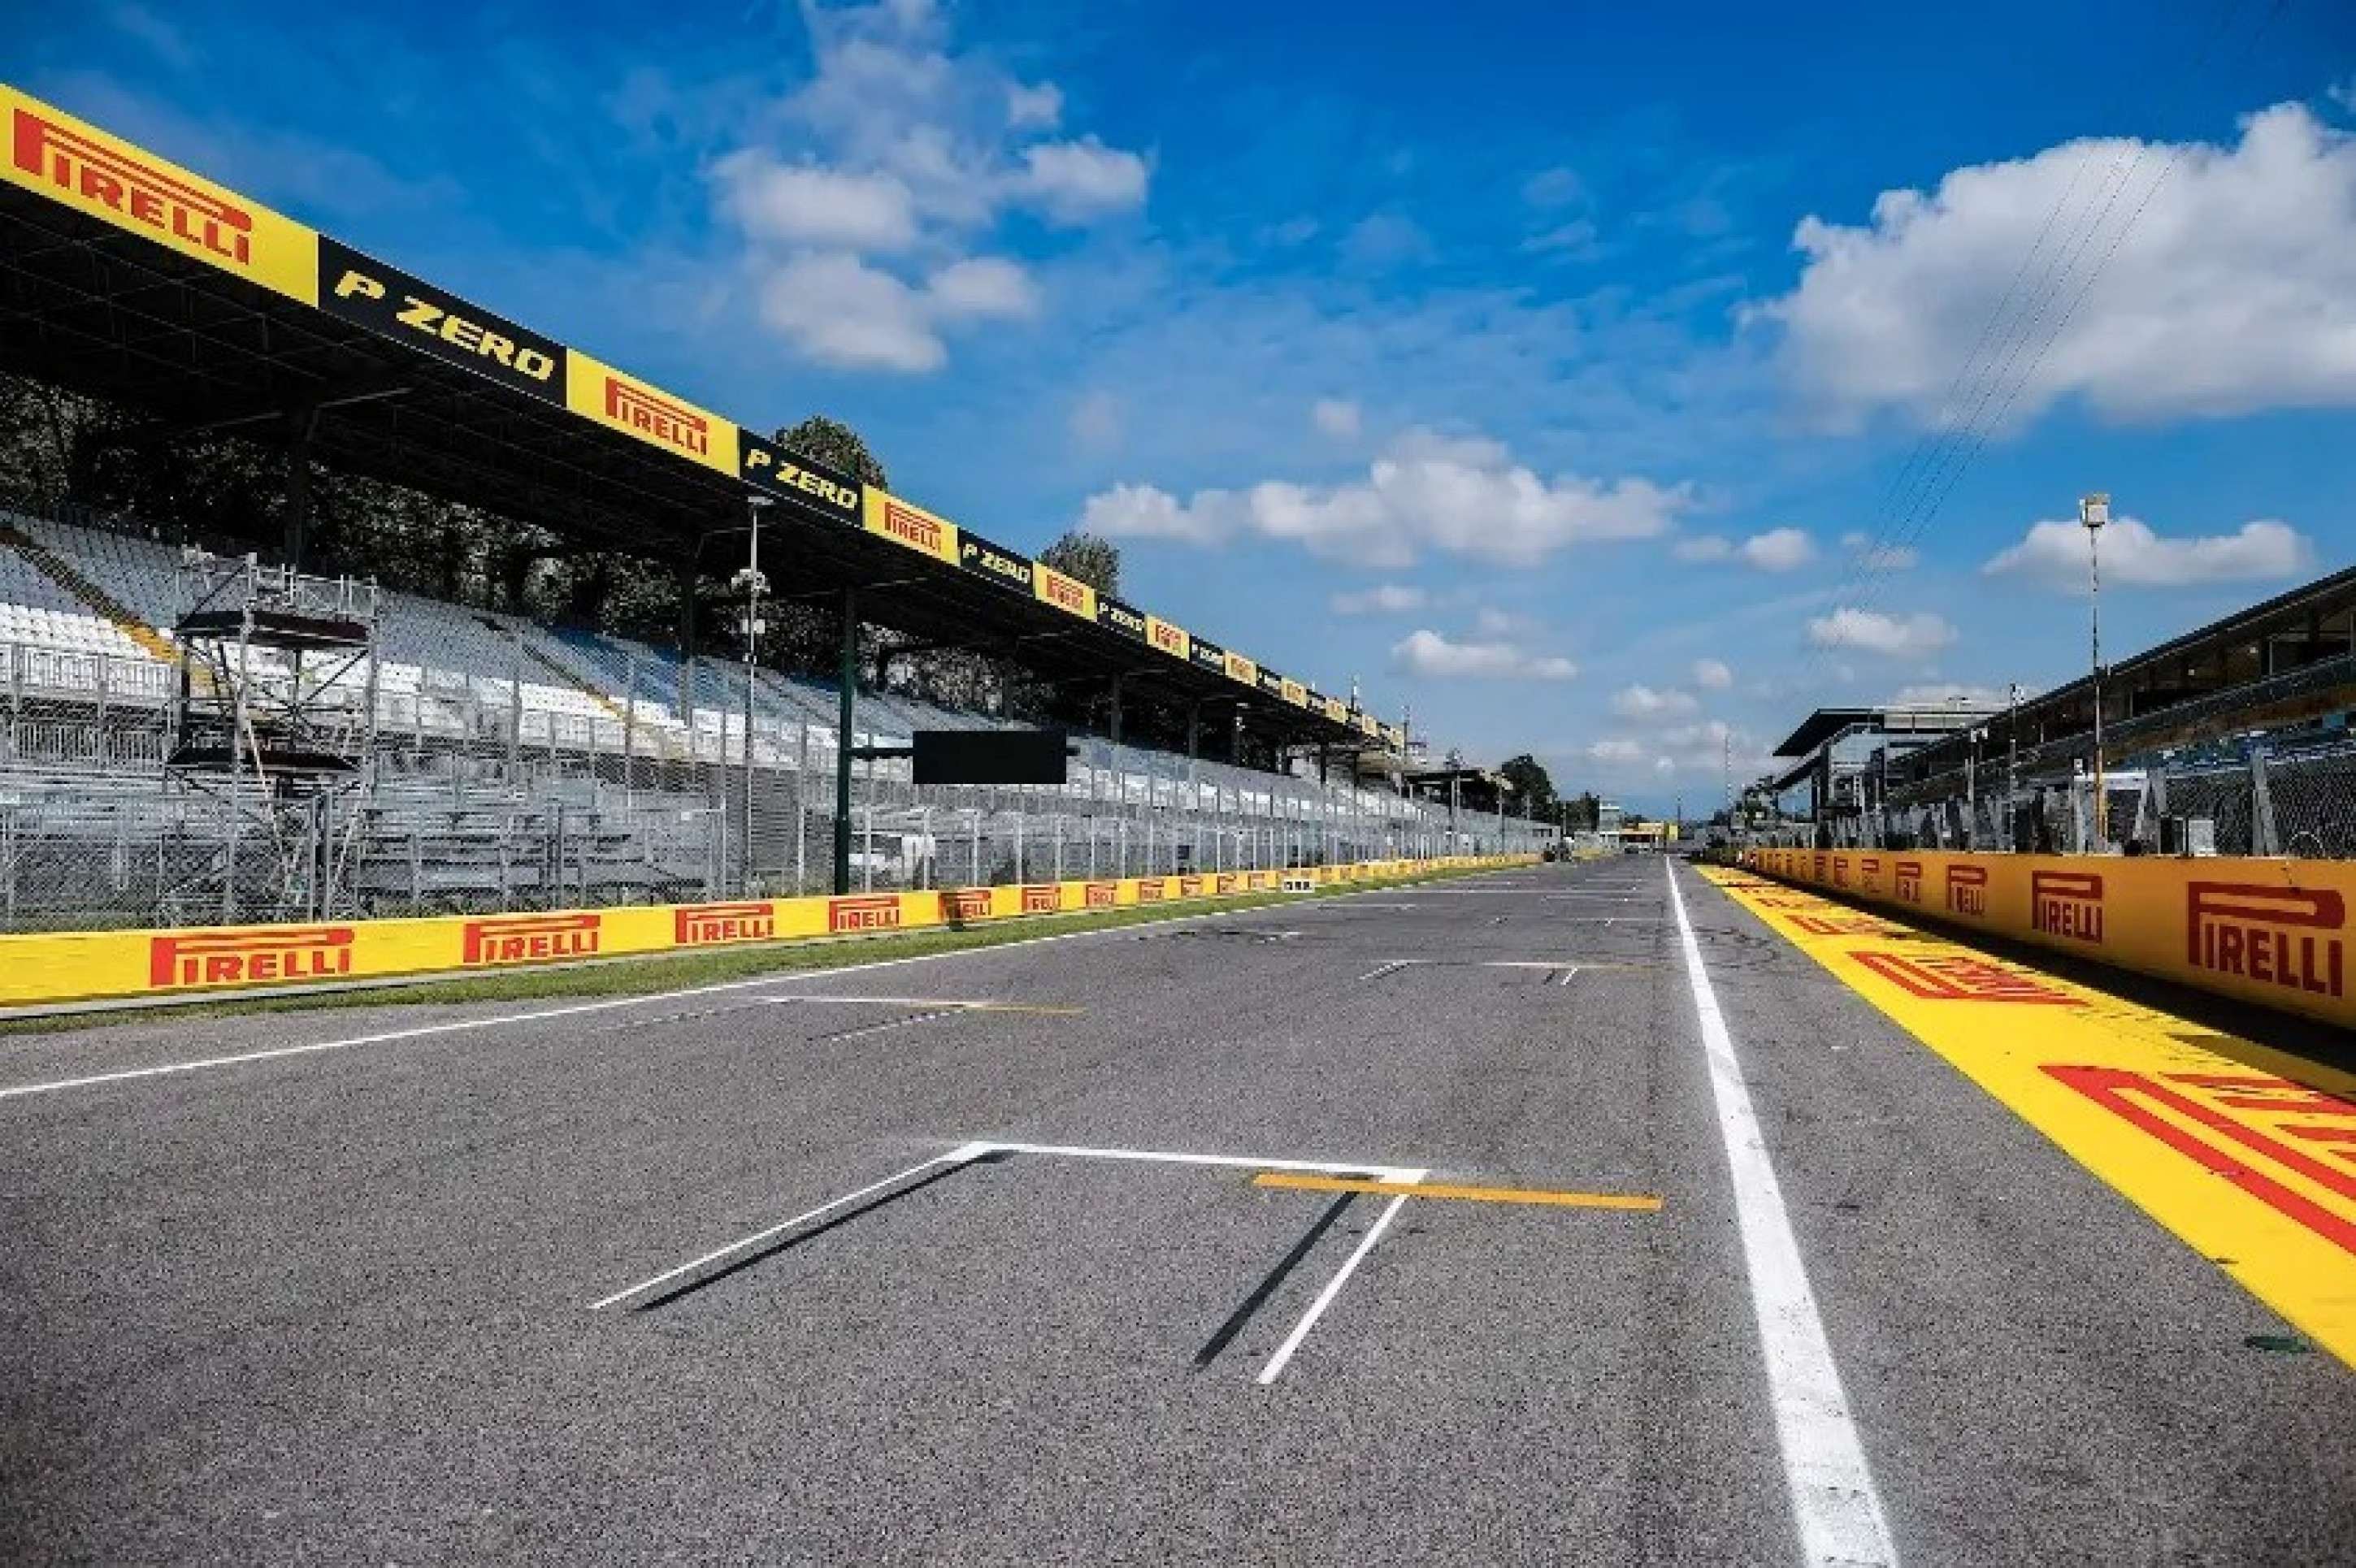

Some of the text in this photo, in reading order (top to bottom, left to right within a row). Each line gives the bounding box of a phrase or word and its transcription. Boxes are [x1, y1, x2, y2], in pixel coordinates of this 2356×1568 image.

[13, 107, 252, 266] PIRELLI
[334, 270, 555, 381] P ZERO
[605, 376, 707, 455] PIRELLI
[745, 448, 858, 509] P ZERO
[884, 501, 941, 553] PIRELLI
[962, 544, 978, 559] P
[675, 903, 774, 943] PIRELLI
[829, 894, 900, 932] PIRELLI
[2033, 870, 2102, 944] PIRELLI
[150, 929, 355, 989] PIRELLI
[463, 915, 601, 964] PIRELLI
[2188, 881, 2345, 997] PIRELLI
